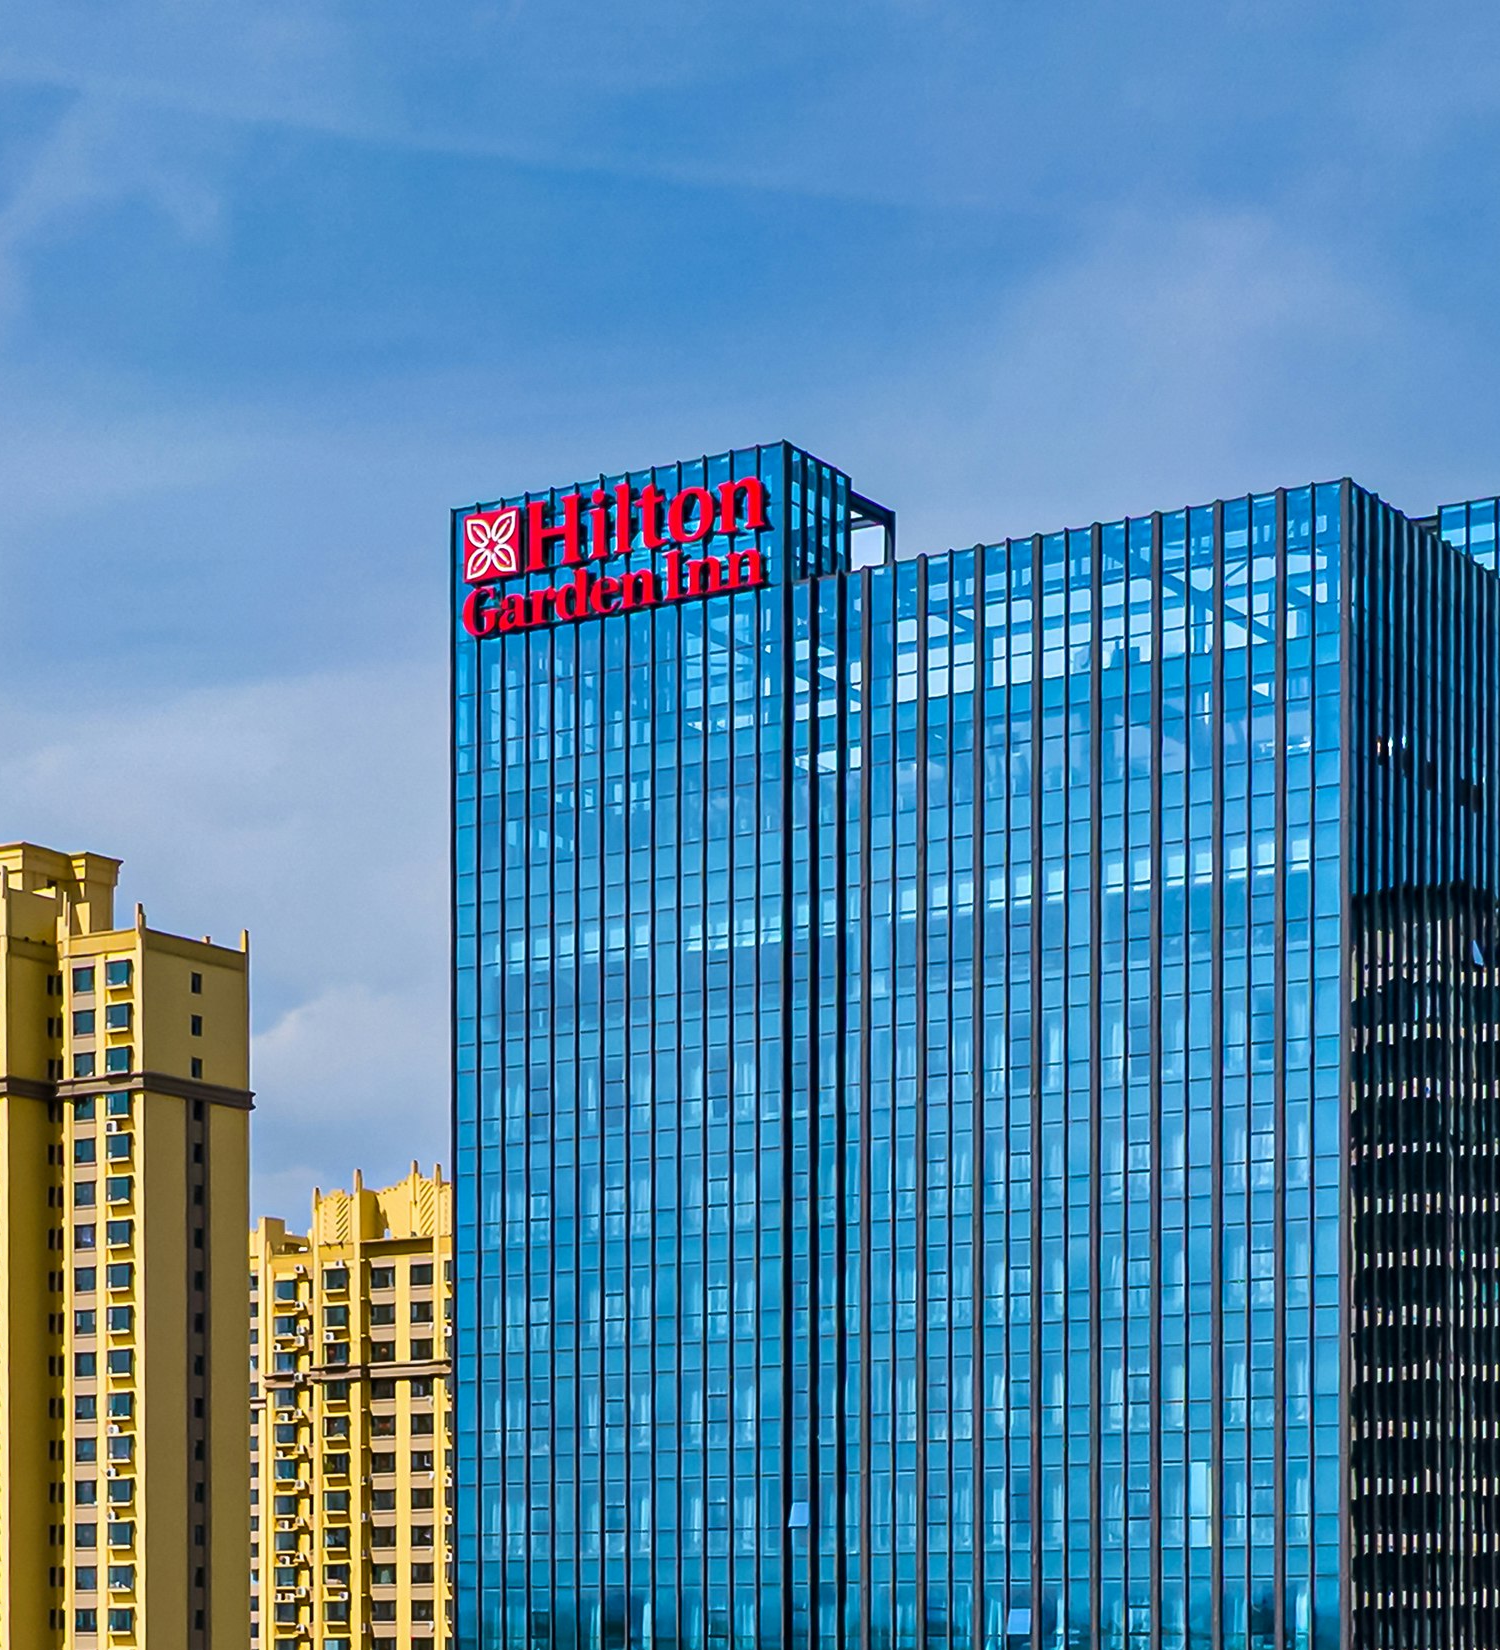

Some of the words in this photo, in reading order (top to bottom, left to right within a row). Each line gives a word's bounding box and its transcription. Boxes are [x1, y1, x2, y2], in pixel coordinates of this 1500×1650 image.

[527, 477, 765, 570] Hilton
[462, 567, 657, 637] Garden
[663, 549, 764, 600] Inn
